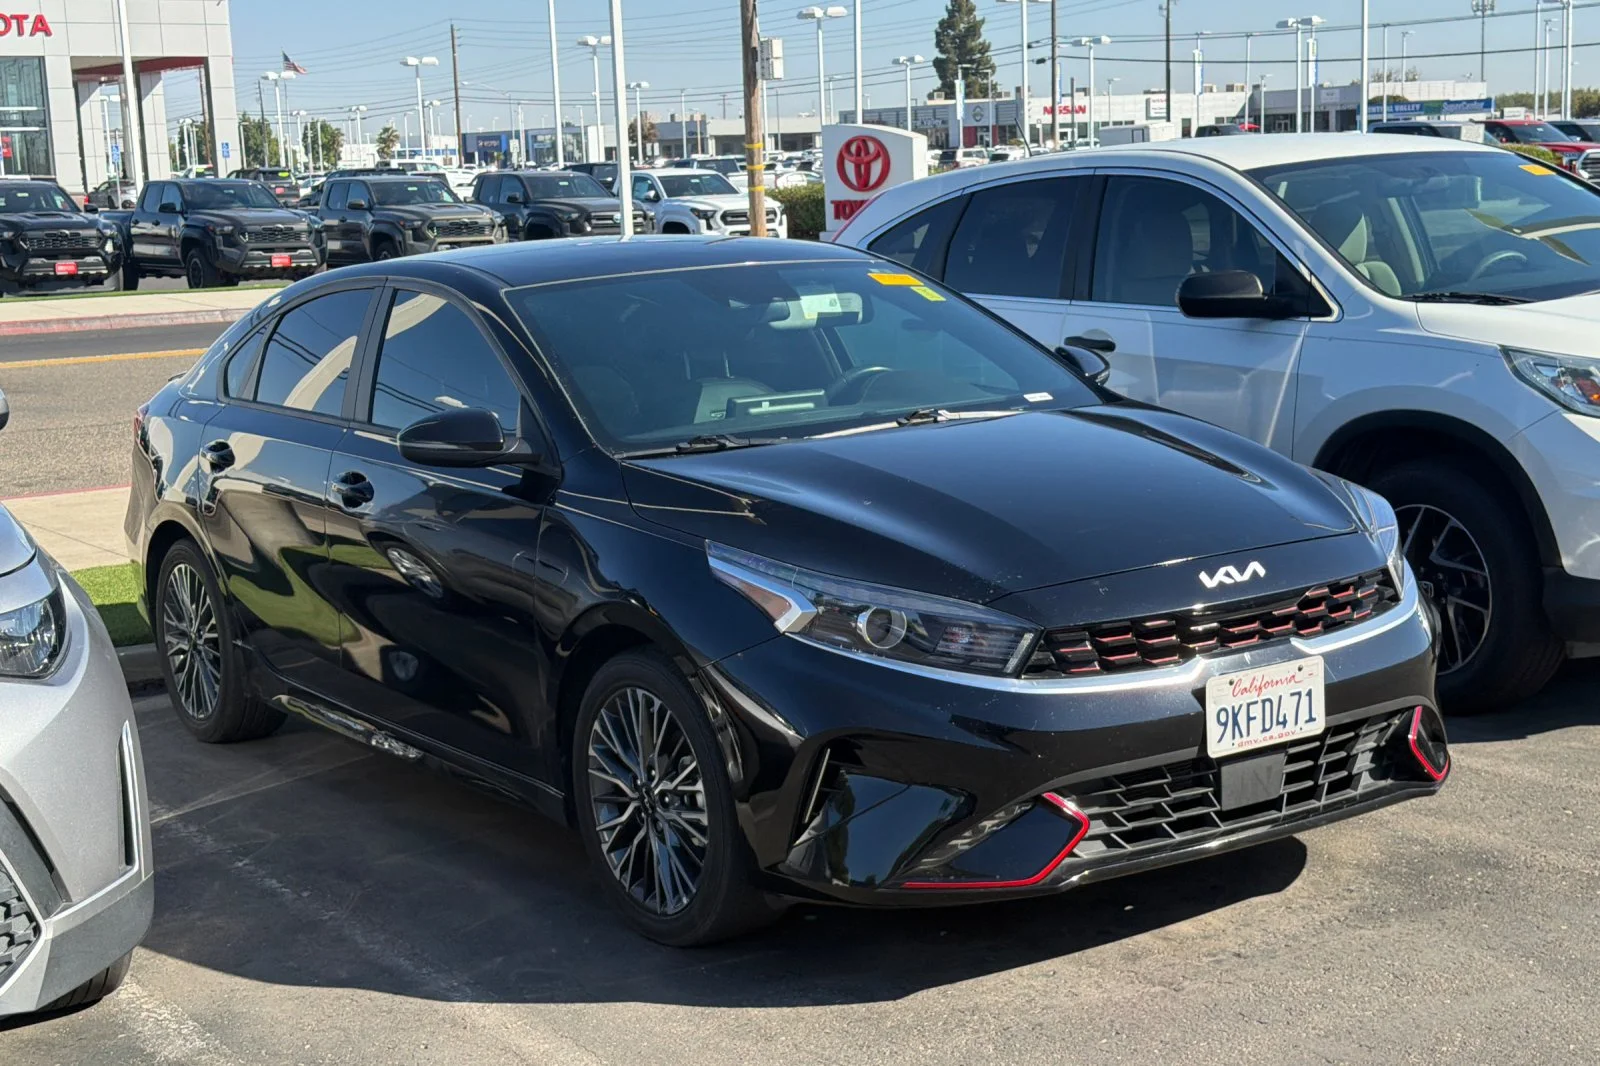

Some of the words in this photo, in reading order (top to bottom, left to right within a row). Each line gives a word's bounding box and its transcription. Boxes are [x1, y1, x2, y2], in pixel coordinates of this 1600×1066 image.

[1043, 104, 1087, 115] NSSAN
[1395, 103, 1421, 112] VALLEY
[1199, 561, 1266, 589] KIA
[1232, 674, 1304, 698] California
[1216, 688, 1316, 744] 9KFD471
[1237, 729, 1297, 748] dmv.ca.gov
